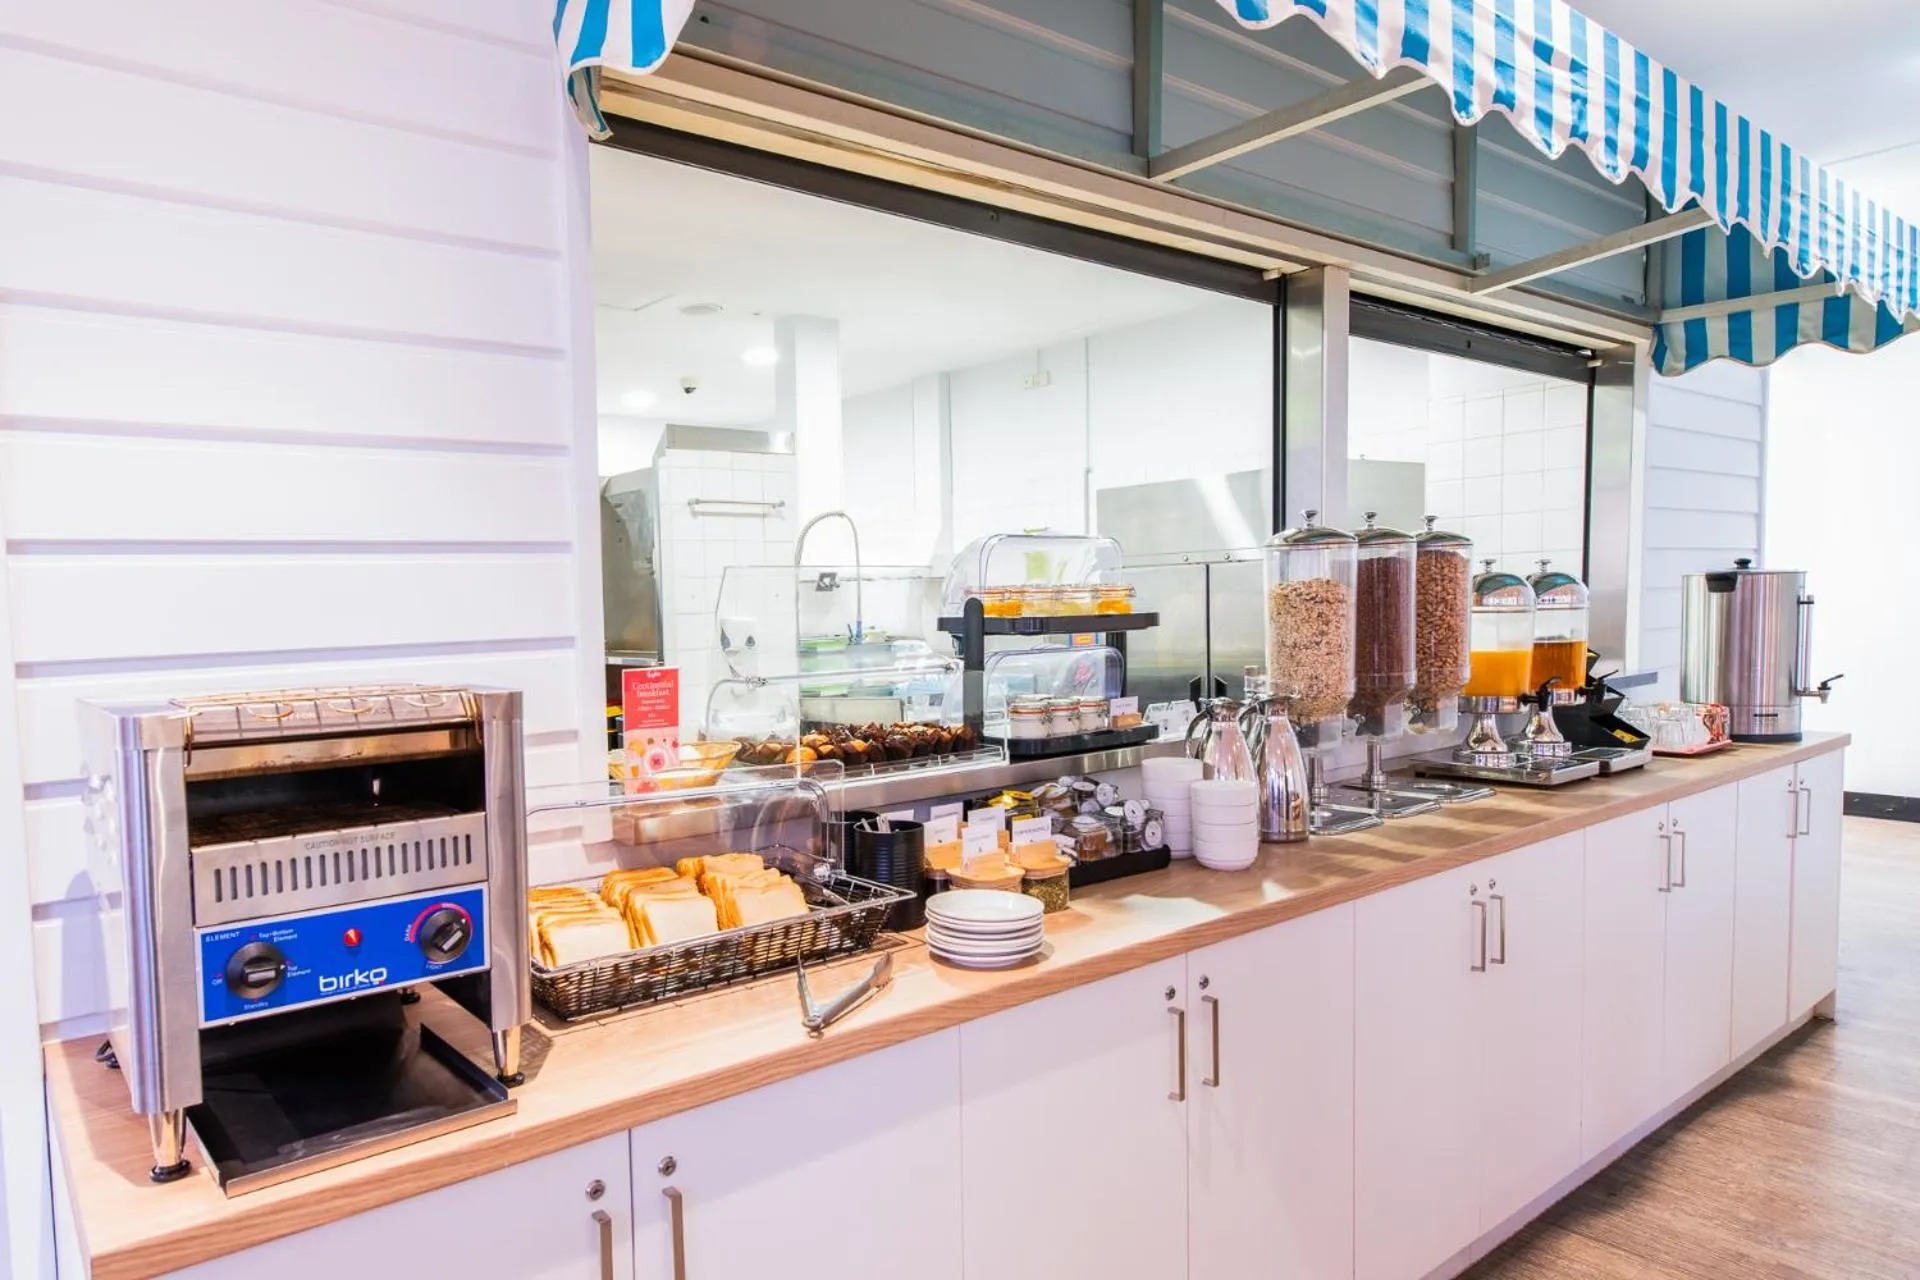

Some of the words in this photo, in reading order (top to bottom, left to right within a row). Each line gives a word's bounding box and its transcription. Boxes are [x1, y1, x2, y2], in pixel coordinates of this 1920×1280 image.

[360, 831, 396, 843] SURFACE
[205, 931, 241, 942] ELEMENT
[273, 933, 298, 942] Element
[287, 968, 312, 978] Element
[319, 967, 388, 993] birko
